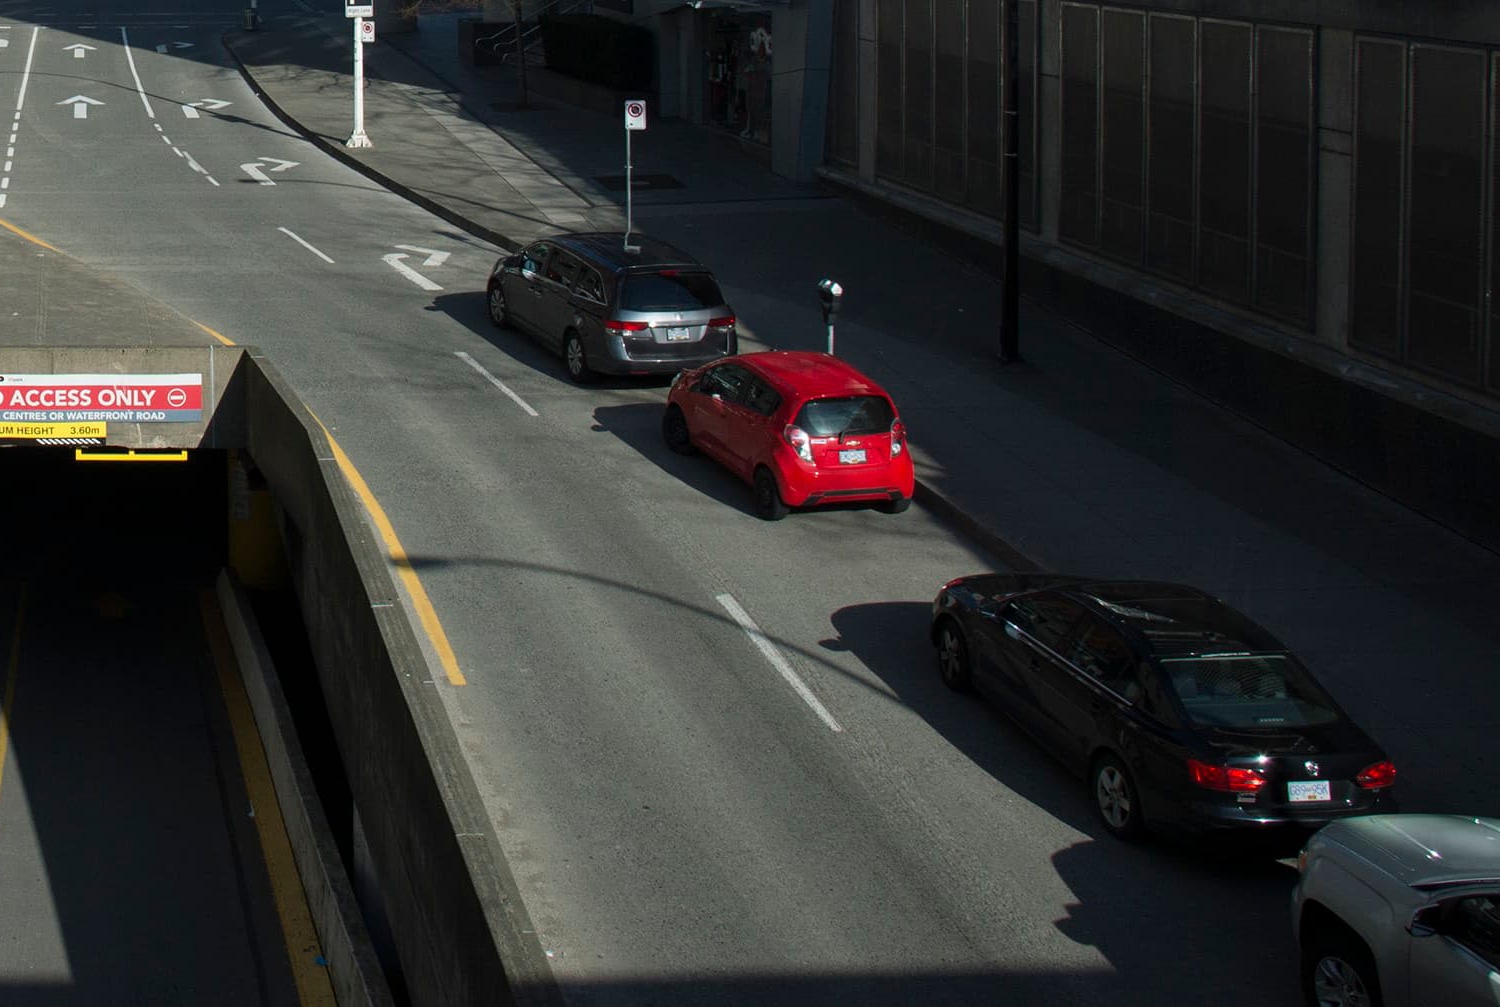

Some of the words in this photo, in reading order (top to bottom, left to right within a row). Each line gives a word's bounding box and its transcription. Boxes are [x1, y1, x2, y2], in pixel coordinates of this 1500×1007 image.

[9, 389, 91, 407] ACCESS
[98, 389, 156, 406] ONLY
[3, 411, 47, 420] CENTRES
[49, 411, 63, 420] OR
[66, 411, 133, 420] WATERFRONT
[136, 411, 166, 420] ROAD
[17, 426, 54, 434] HEIGHT
[70, 426, 100, 434] 3.60m
